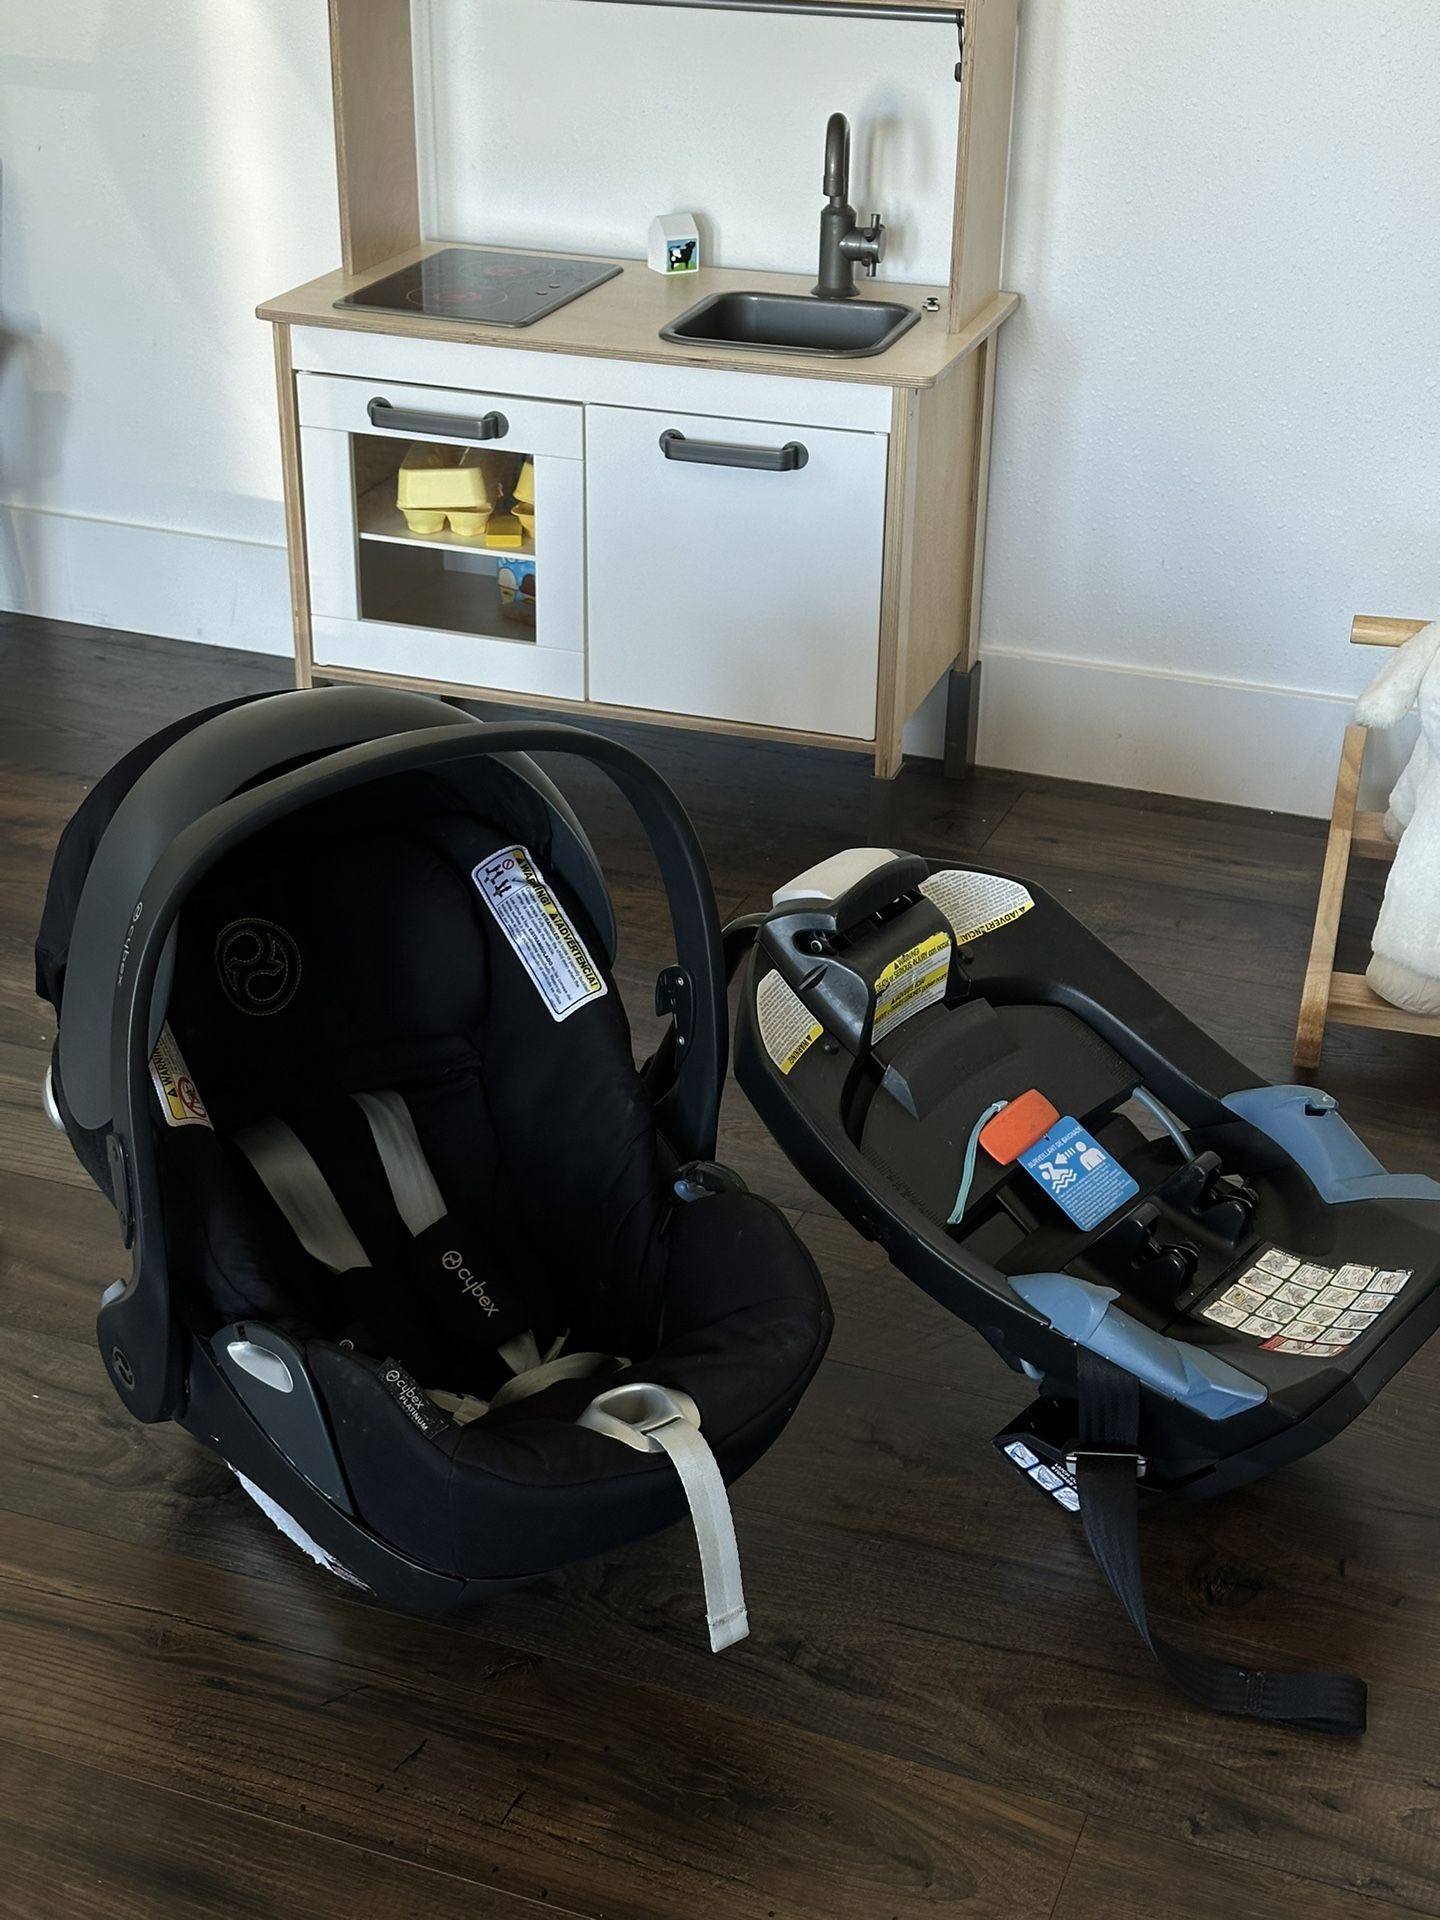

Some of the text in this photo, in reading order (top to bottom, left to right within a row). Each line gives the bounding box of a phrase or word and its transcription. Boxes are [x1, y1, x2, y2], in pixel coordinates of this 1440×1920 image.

[118, 925, 135, 987] cybex
[458, 1268, 499, 1317] cybex
[397, 1378, 424, 1409] cybex
[399, 1395, 430, 1432] PLATINUM
